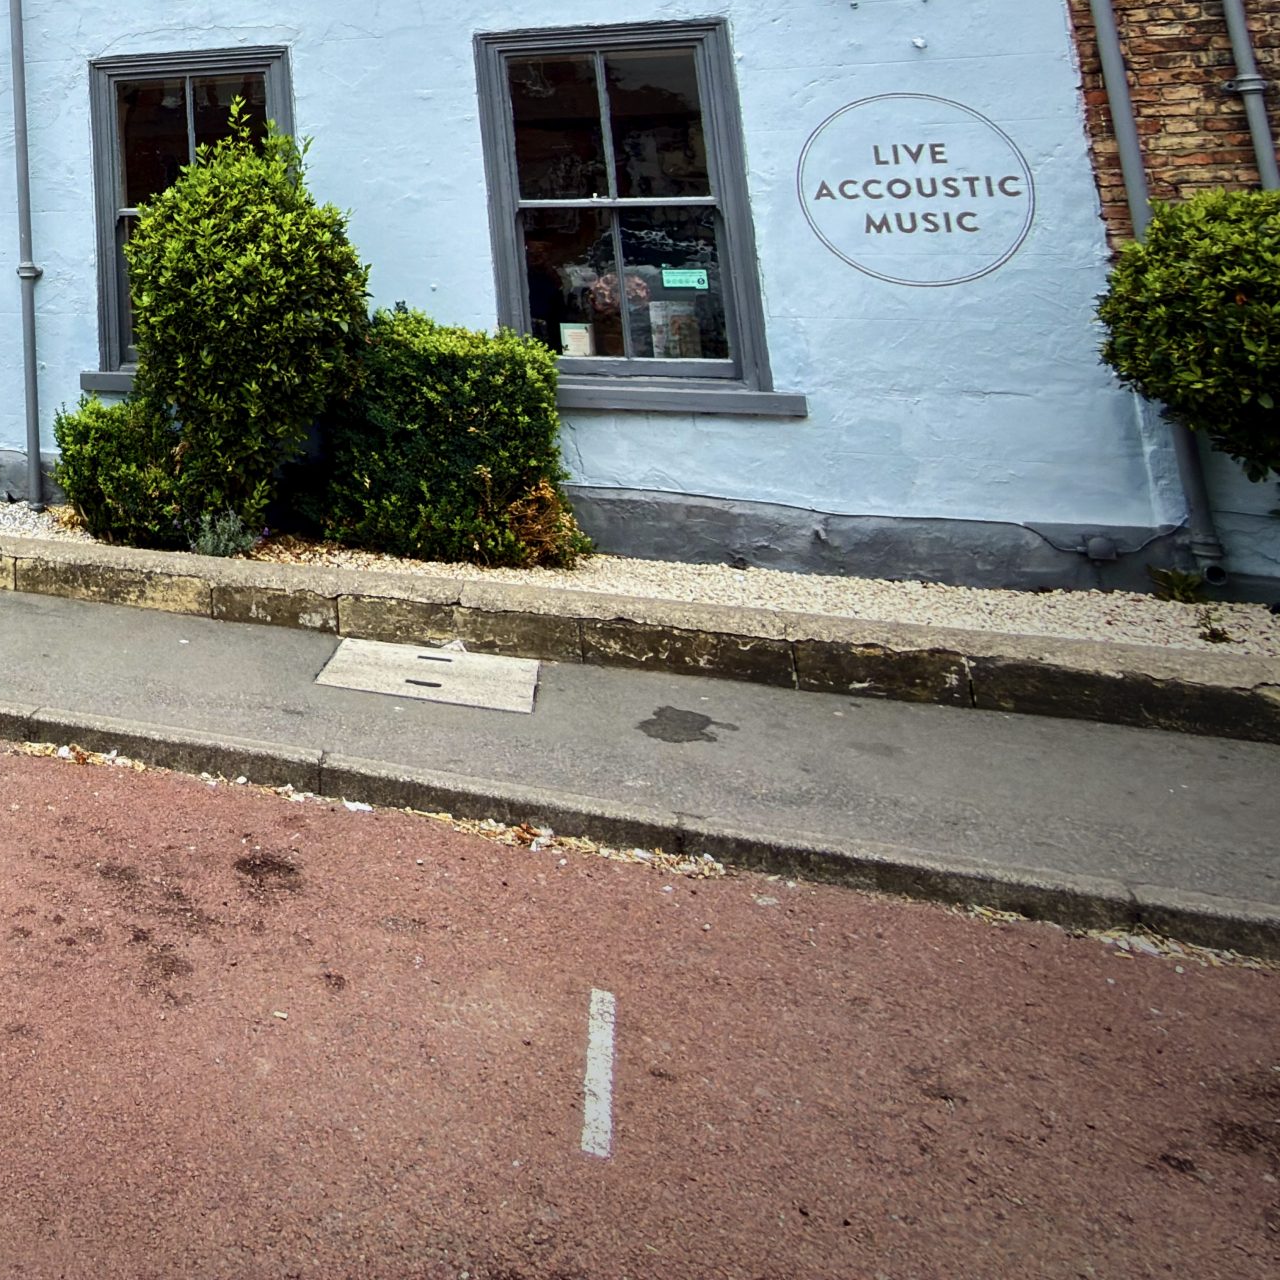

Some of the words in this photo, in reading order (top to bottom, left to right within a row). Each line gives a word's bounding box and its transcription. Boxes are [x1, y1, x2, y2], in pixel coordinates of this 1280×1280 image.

[873, 143, 948, 166] LIVE
[814, 175, 1023, 201] ACCOUSTIC
[864, 211, 981, 234] MUSIC
